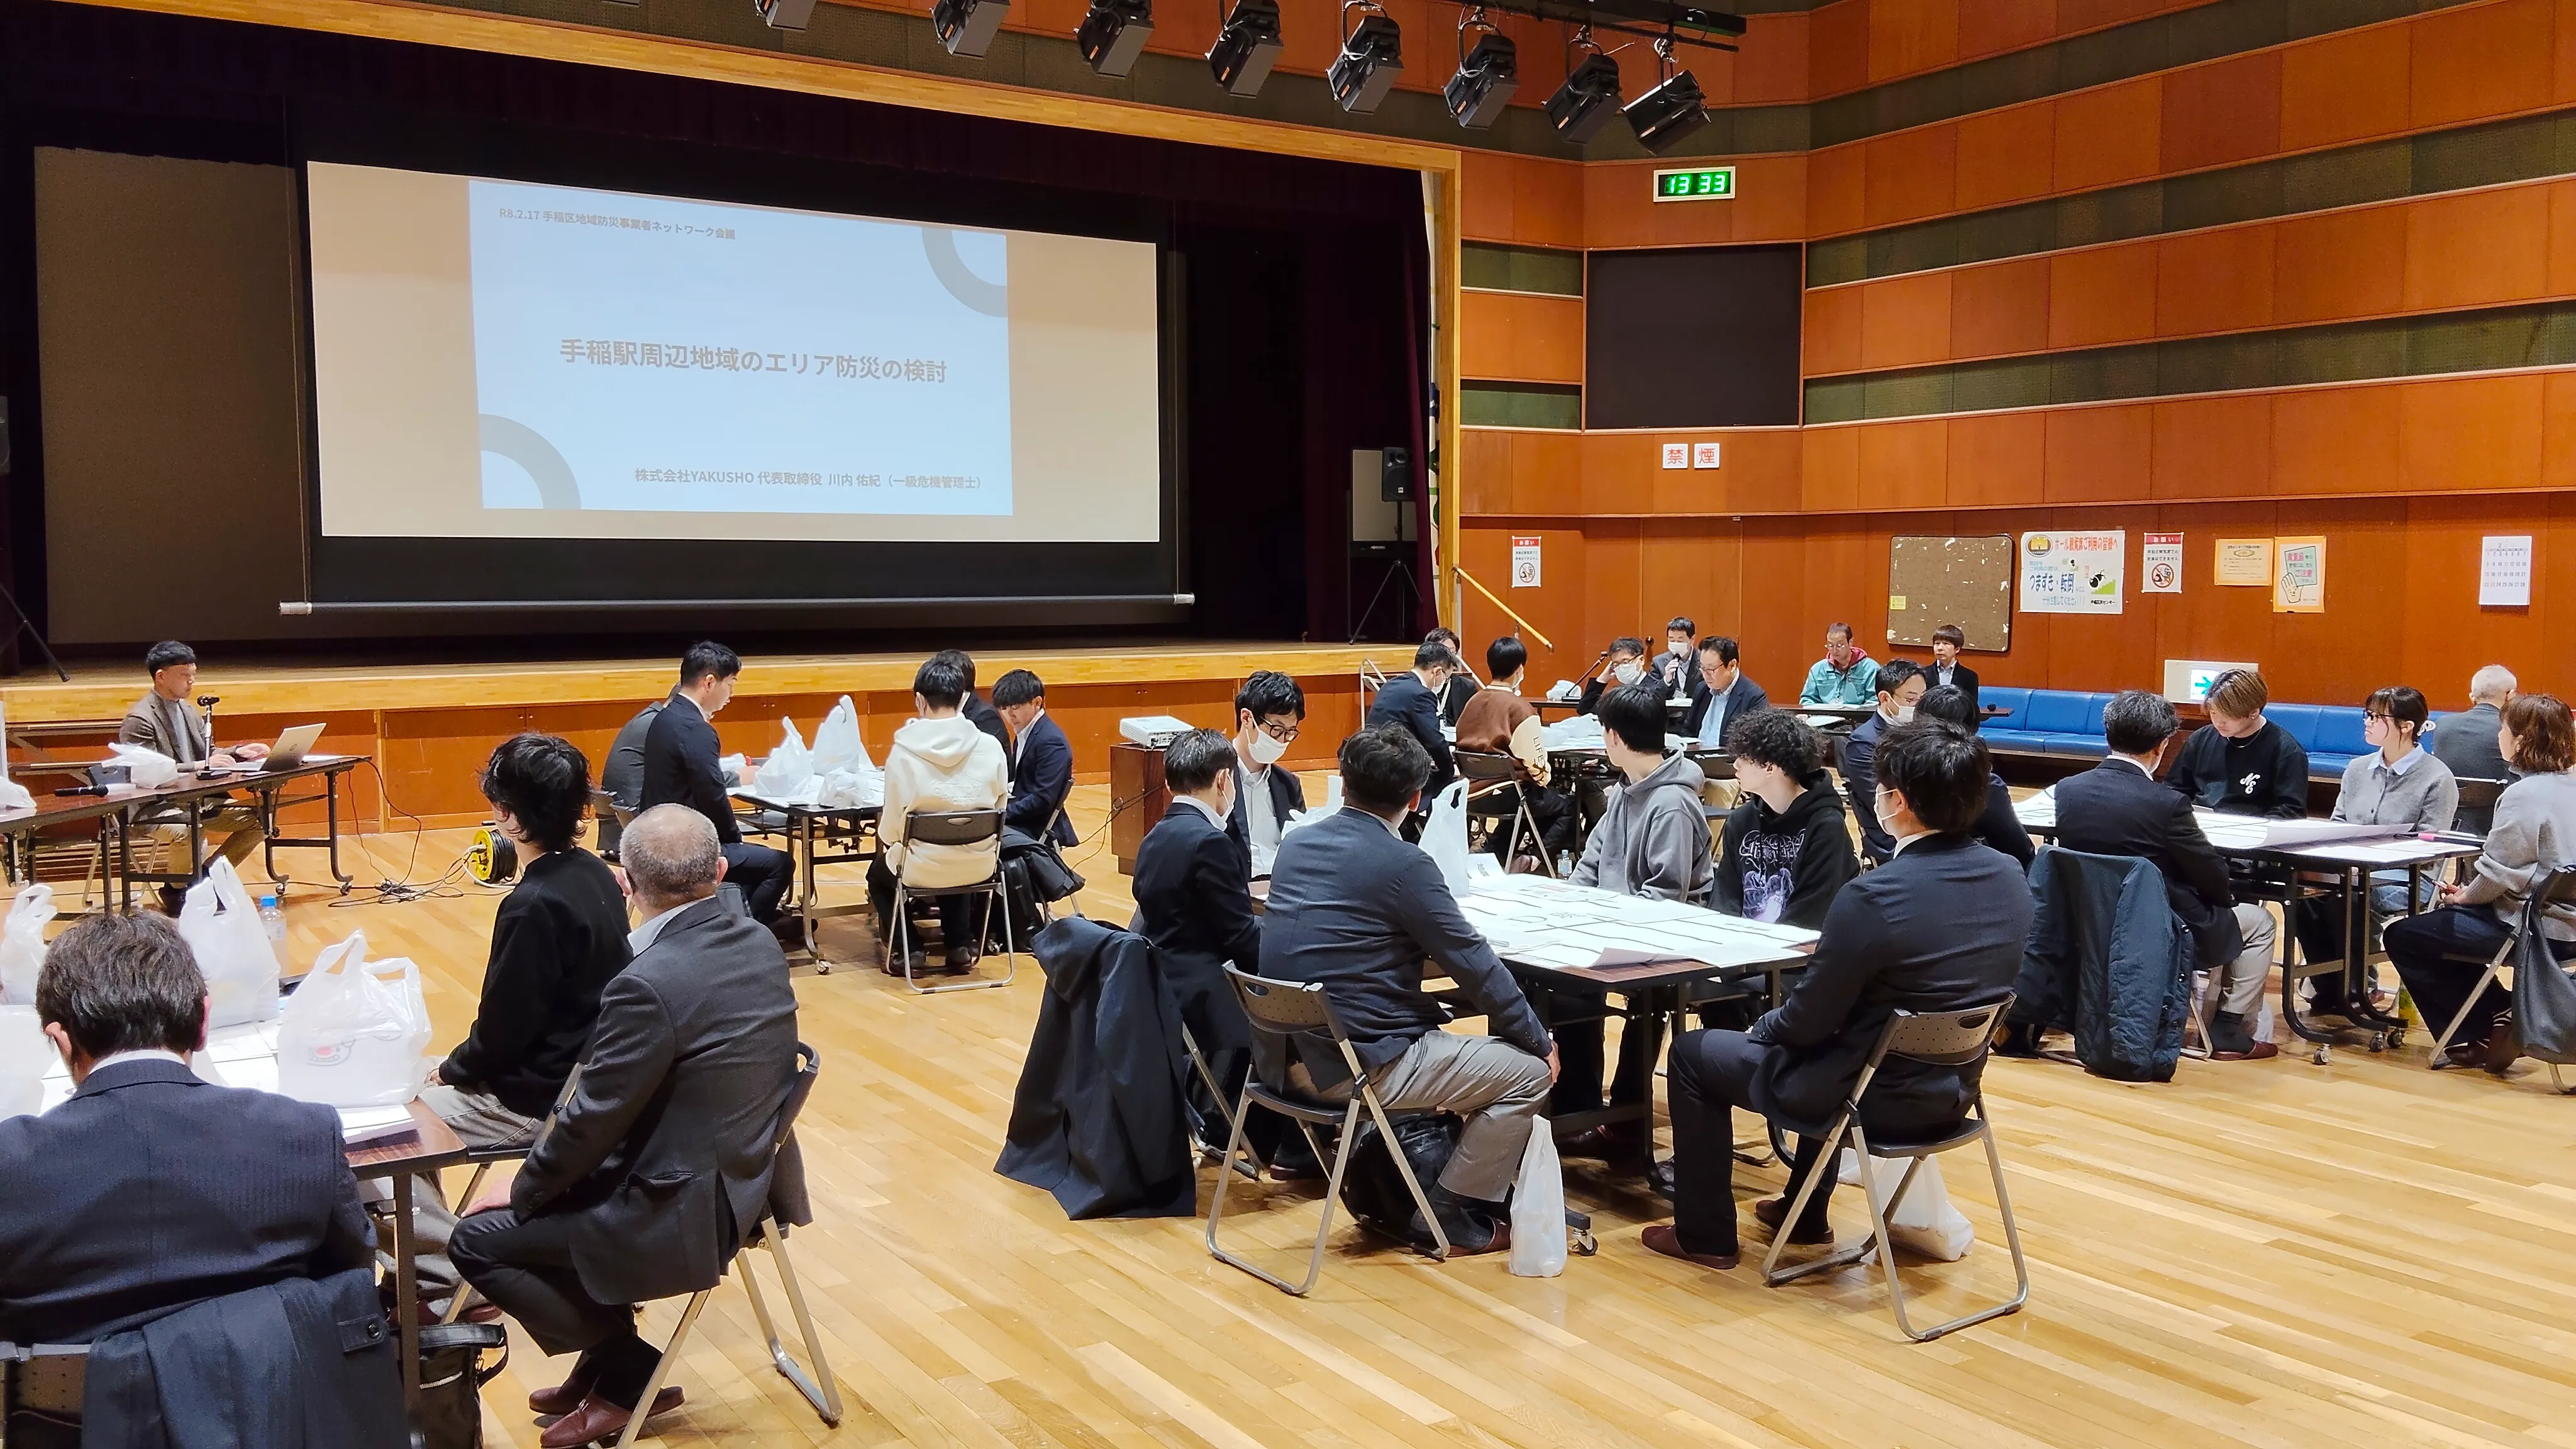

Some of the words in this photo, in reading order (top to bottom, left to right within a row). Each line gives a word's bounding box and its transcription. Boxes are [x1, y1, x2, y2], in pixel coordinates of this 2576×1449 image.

[1670, 175, 1690, 194] 13
[1699, 174, 1726, 193] 33
[499, 208, 540, 220] R8.2.17
[542, 211, 736, 240] 手稲区地域防災事業者ネットワーク会議
[560, 338, 948, 384] 手稲駅周辺地域のエリア防災の検討
[1667, 448, 1715, 464] 禁煙
[635, 468, 755, 484] 株式会社YAKUSHO
[757, 471, 823, 486] 代表取締役
[828, 474, 853, 486] 川内
